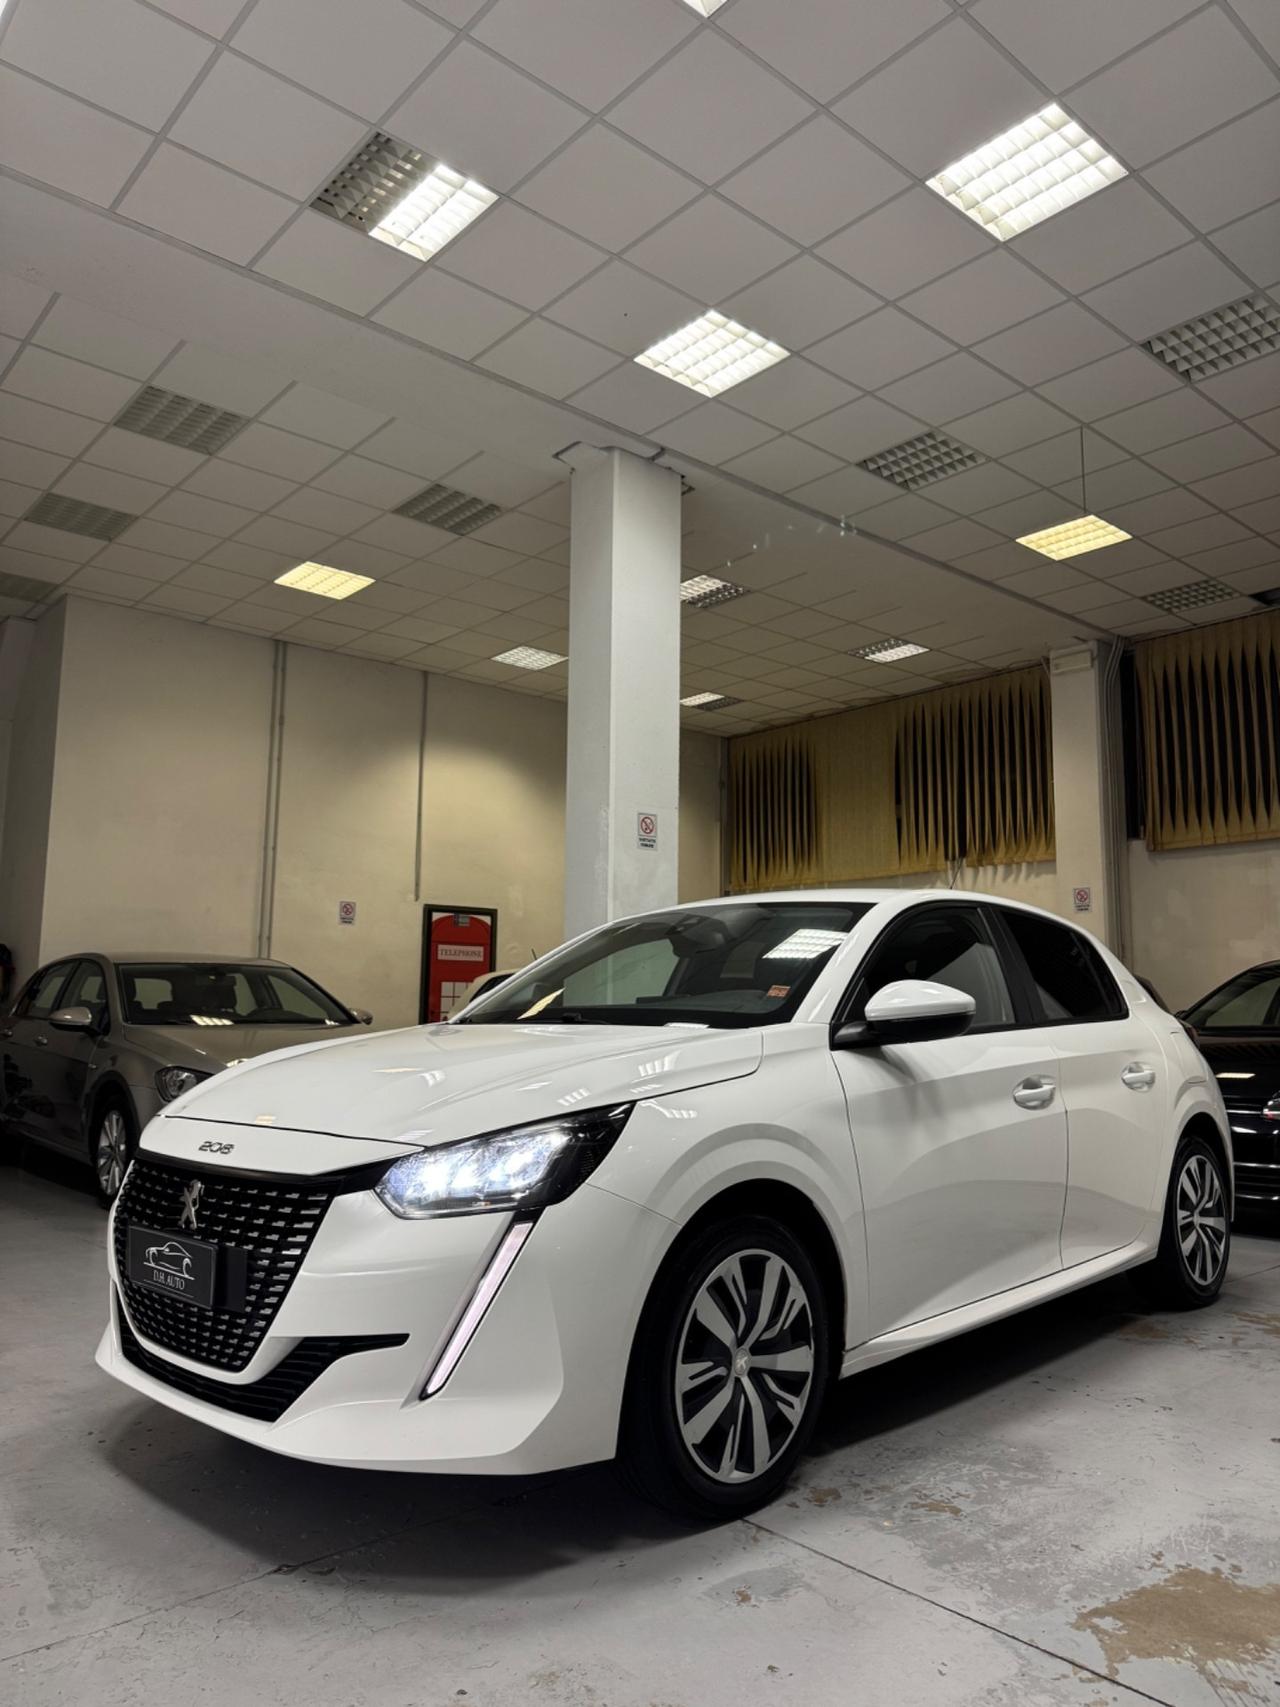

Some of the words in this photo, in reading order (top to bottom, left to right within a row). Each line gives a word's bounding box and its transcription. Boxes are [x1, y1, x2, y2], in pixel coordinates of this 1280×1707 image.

[440, 948, 482, 958] TELEPHONE
[198, 1140, 234, 1154] 208
[166, 1275, 185, 1290] AUTO
